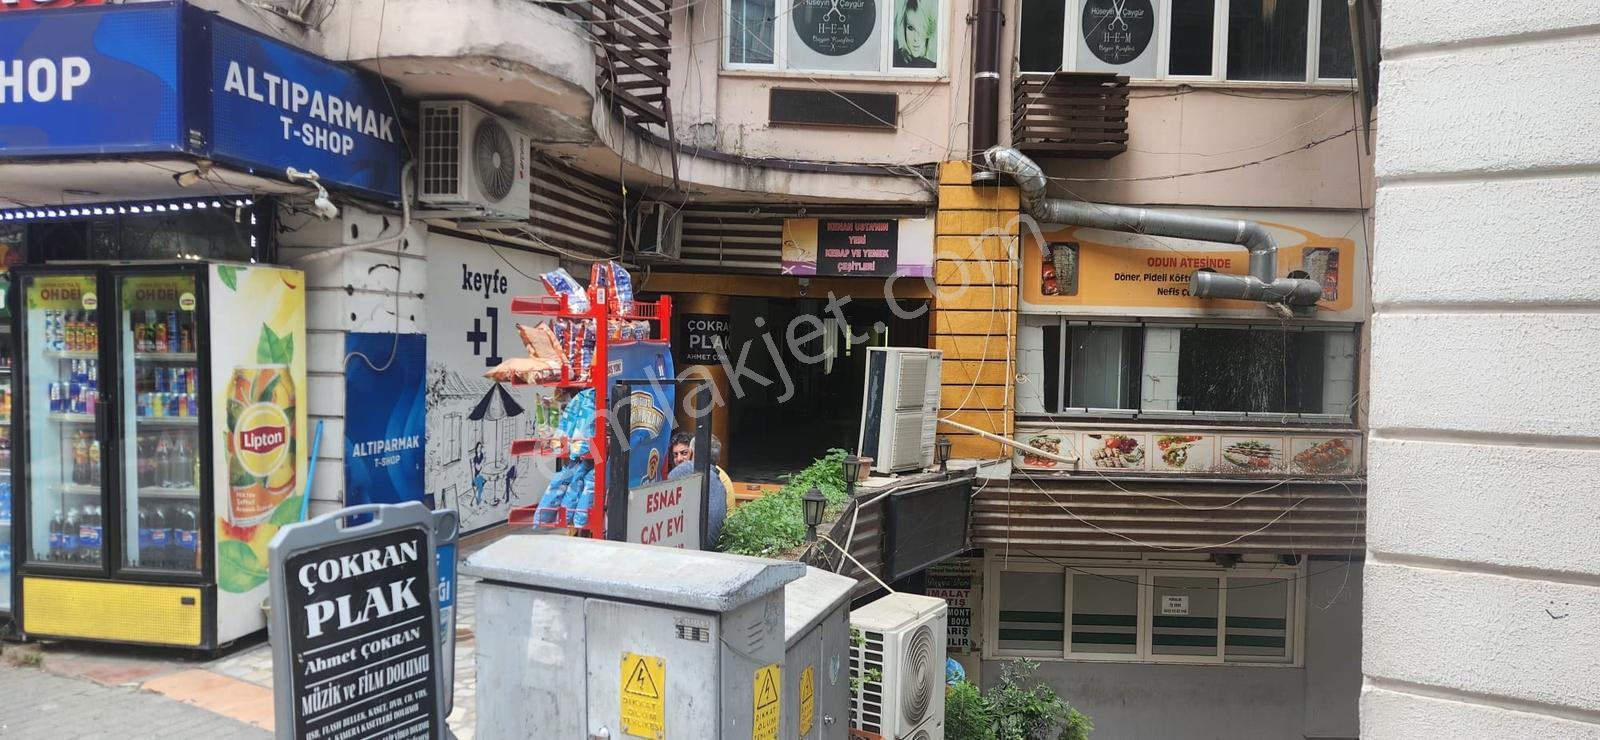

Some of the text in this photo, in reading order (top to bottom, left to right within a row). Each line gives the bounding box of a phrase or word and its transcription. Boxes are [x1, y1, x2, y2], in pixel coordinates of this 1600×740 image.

[818, 23, 850, 35] H-E-M
[223, 60, 394, 143] ALTIPARMAK
[279, 115, 354, 156] T-SHOP
[824, 248, 889, 258] KEBAP VE YEMEK
[1147, 257, 1177, 268] ODUN
[462, 263, 507, 299] keyfe
[1114, 272, 1142, 283] Döner,
[1157, 287, 1180, 296] Nefis
[687, 320, 730, 332] ÇOKRA
[466, 306, 502, 367] +1
[686, 353, 711, 361] AHMET
[243, 431, 282, 450] Lipton
[352, 434, 420, 458] ALTIPARMAK
[374, 454, 401, 468] T-SHOP
[646, 486, 683, 514] ESNAF
[666, 508, 684, 538] EVİ
[298, 539, 418, 596] ÇOKRAN
[304, 576, 421, 639] PLAK
[947, 599, 967, 608] TIŞ
[951, 618, 970, 626] BOYA
[304, 626, 421, 676] Ahmet ÇOKRAN
[947, 638, 969, 647] ILIR
[301, 653, 430, 716] MÜZİK ve FİLM DOLUMU
